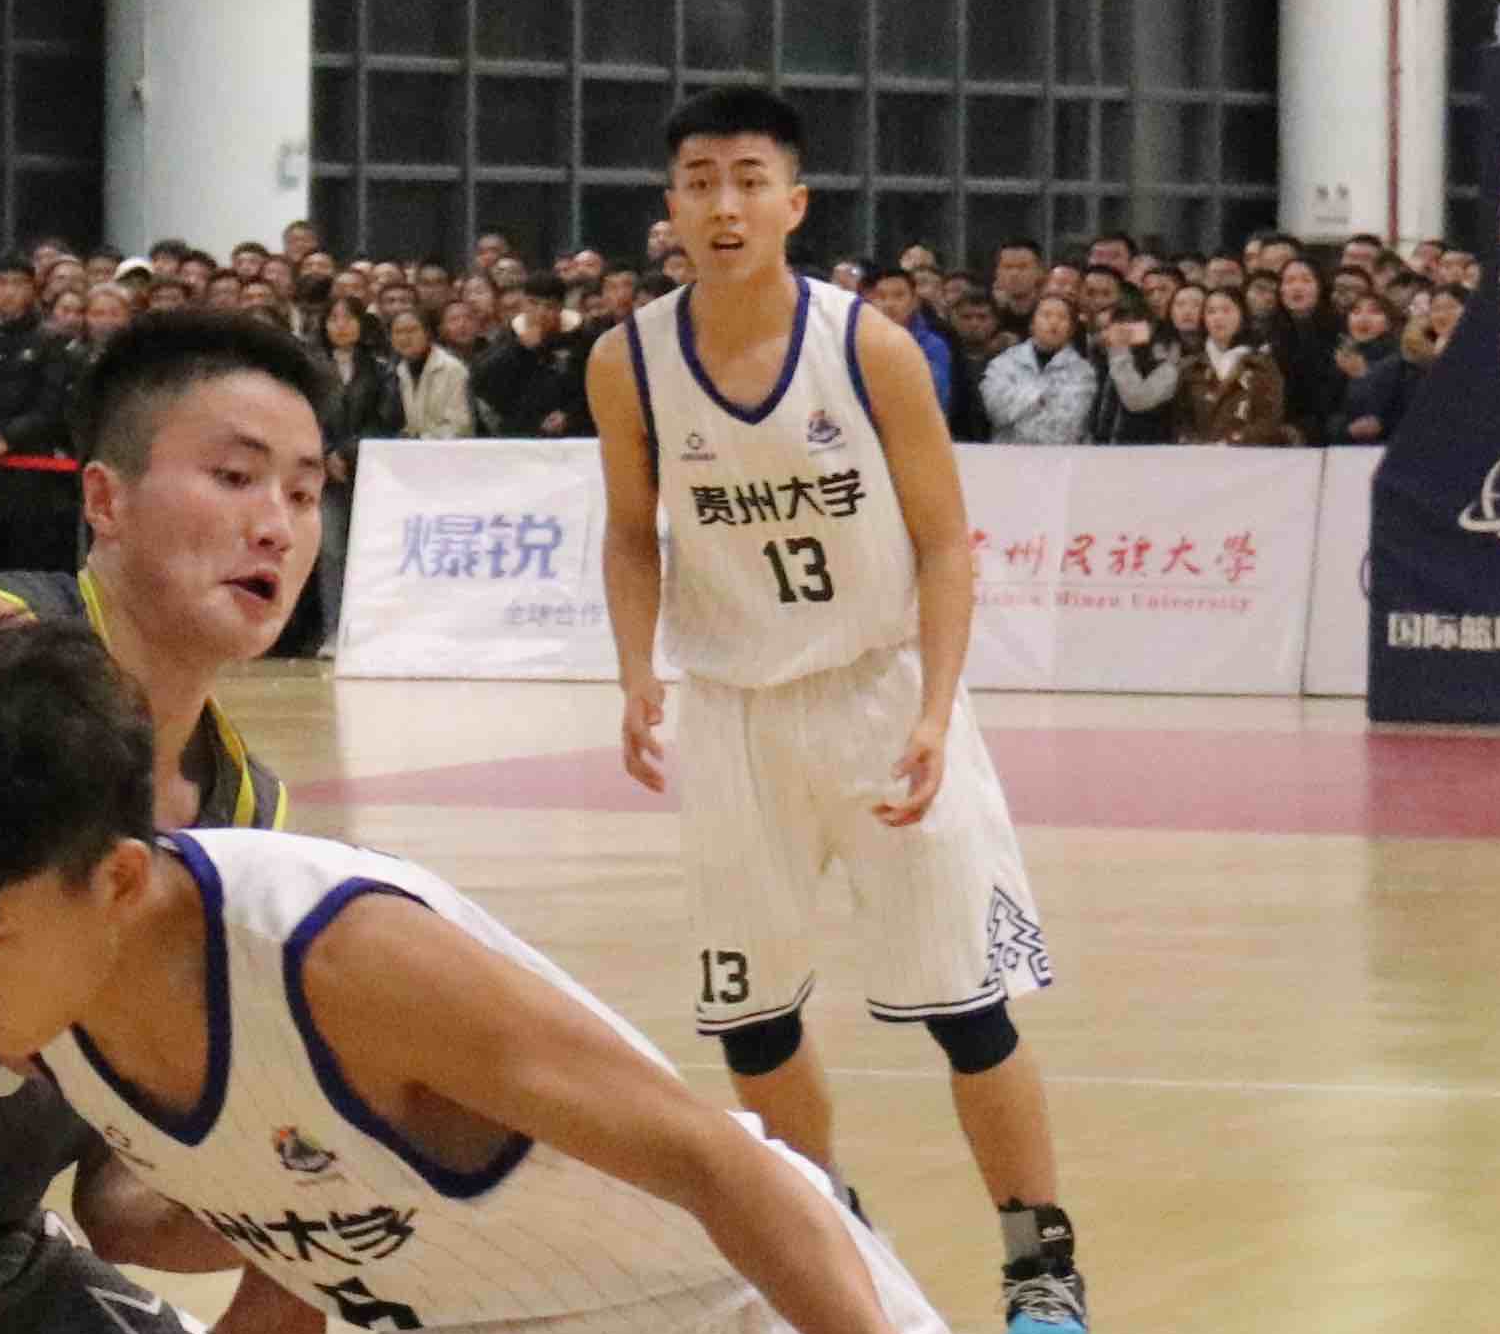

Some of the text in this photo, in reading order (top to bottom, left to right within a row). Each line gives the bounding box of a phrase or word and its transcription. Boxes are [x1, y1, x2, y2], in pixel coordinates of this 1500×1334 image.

[689, 468, 867, 526] 贵州大学
[763, 536, 835, 604] 13
[700, 949, 750, 1004] 13
[155, 1190, 418, 1265] 州大学
